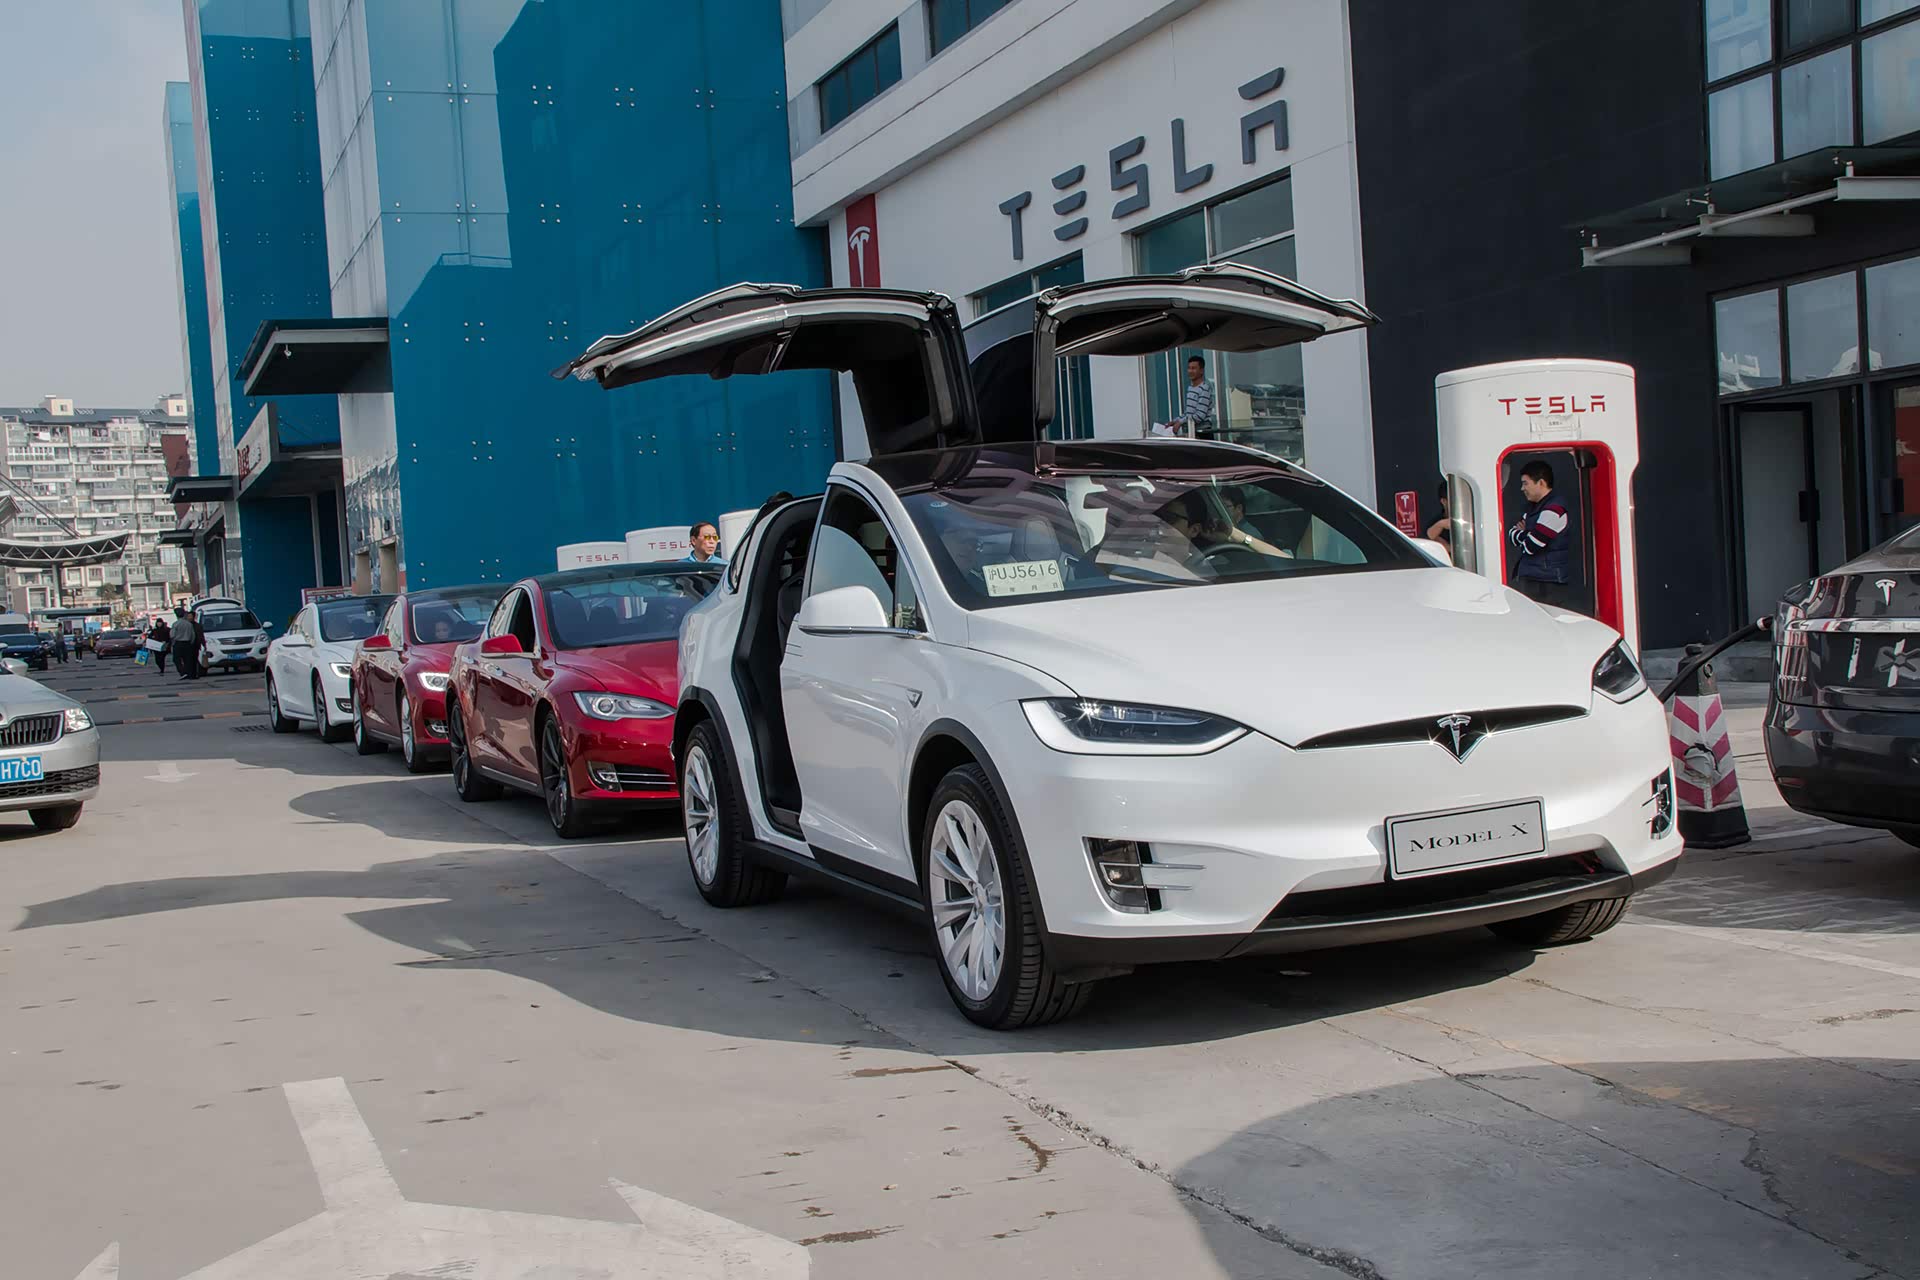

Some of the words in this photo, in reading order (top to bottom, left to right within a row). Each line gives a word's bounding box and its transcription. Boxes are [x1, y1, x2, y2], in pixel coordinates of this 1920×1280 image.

[999, 67, 1289, 260] TESLA
[1497, 395, 1606, 416] TESLA
[576, 554, 619, 563] TESLA
[1410, 830, 1502, 852] MODEL
[1511, 822, 1529, 837] X
